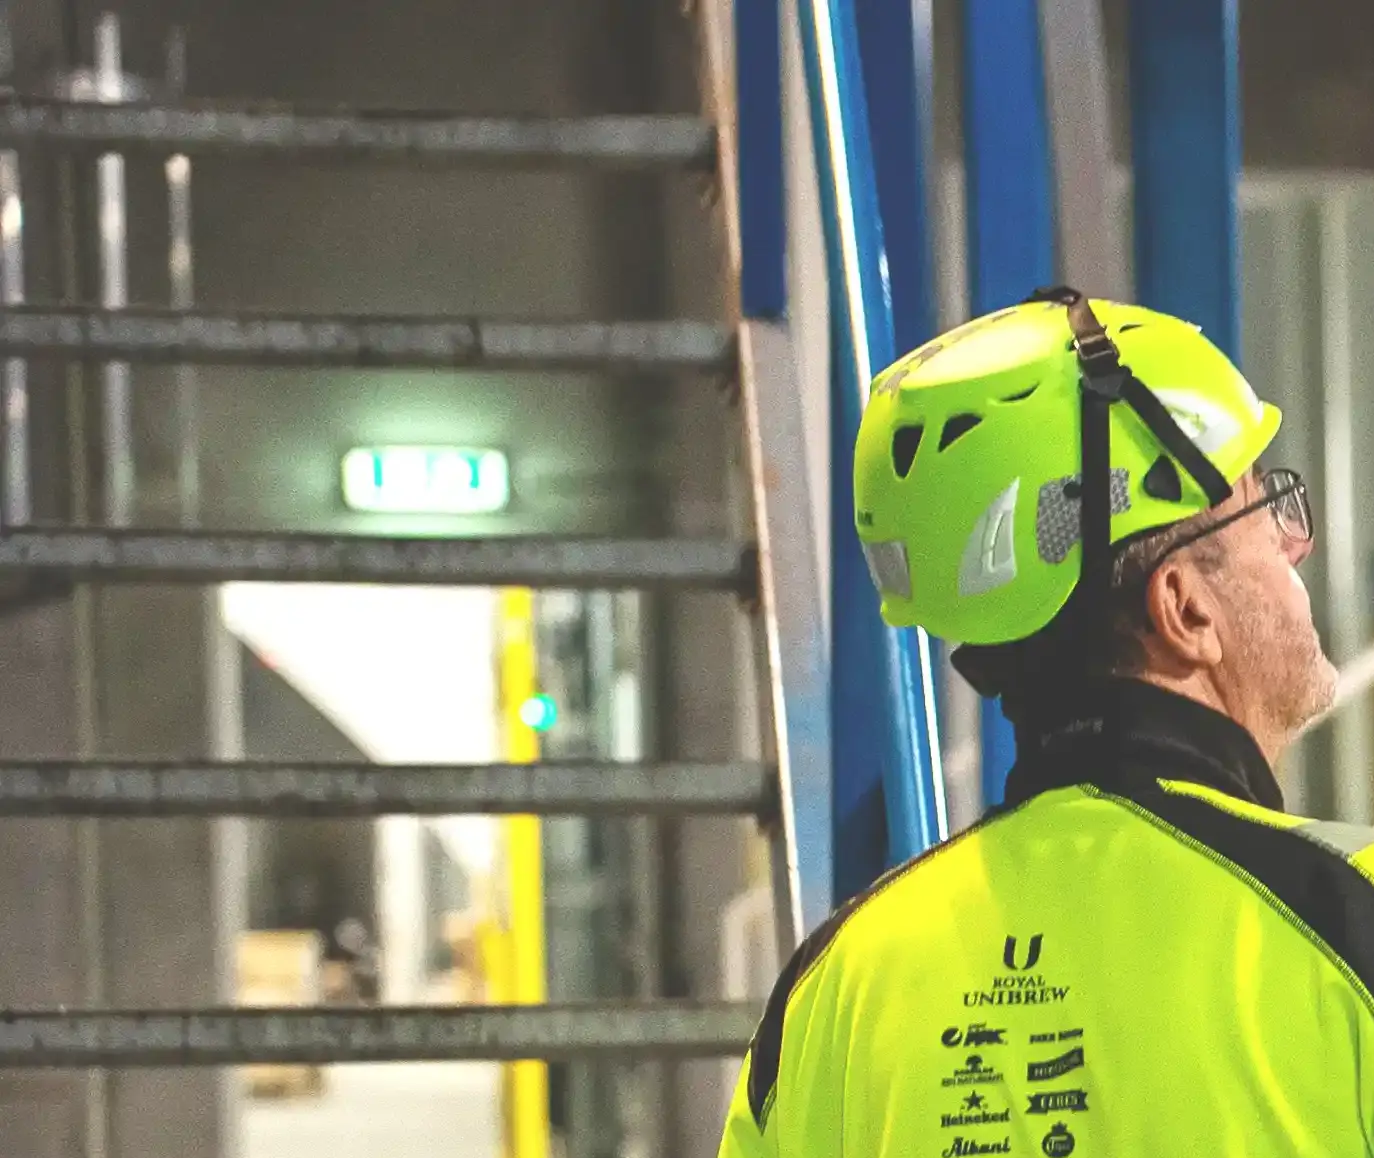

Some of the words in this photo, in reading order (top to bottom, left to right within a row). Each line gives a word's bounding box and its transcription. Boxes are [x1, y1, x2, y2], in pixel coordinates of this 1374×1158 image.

[993, 975, 1046, 989] ROYAL
[963, 986, 1070, 1008] UNIBREW
[941, 1108, 1011, 1128] Heineken
[942, 1136, 1011, 1158] Albani
